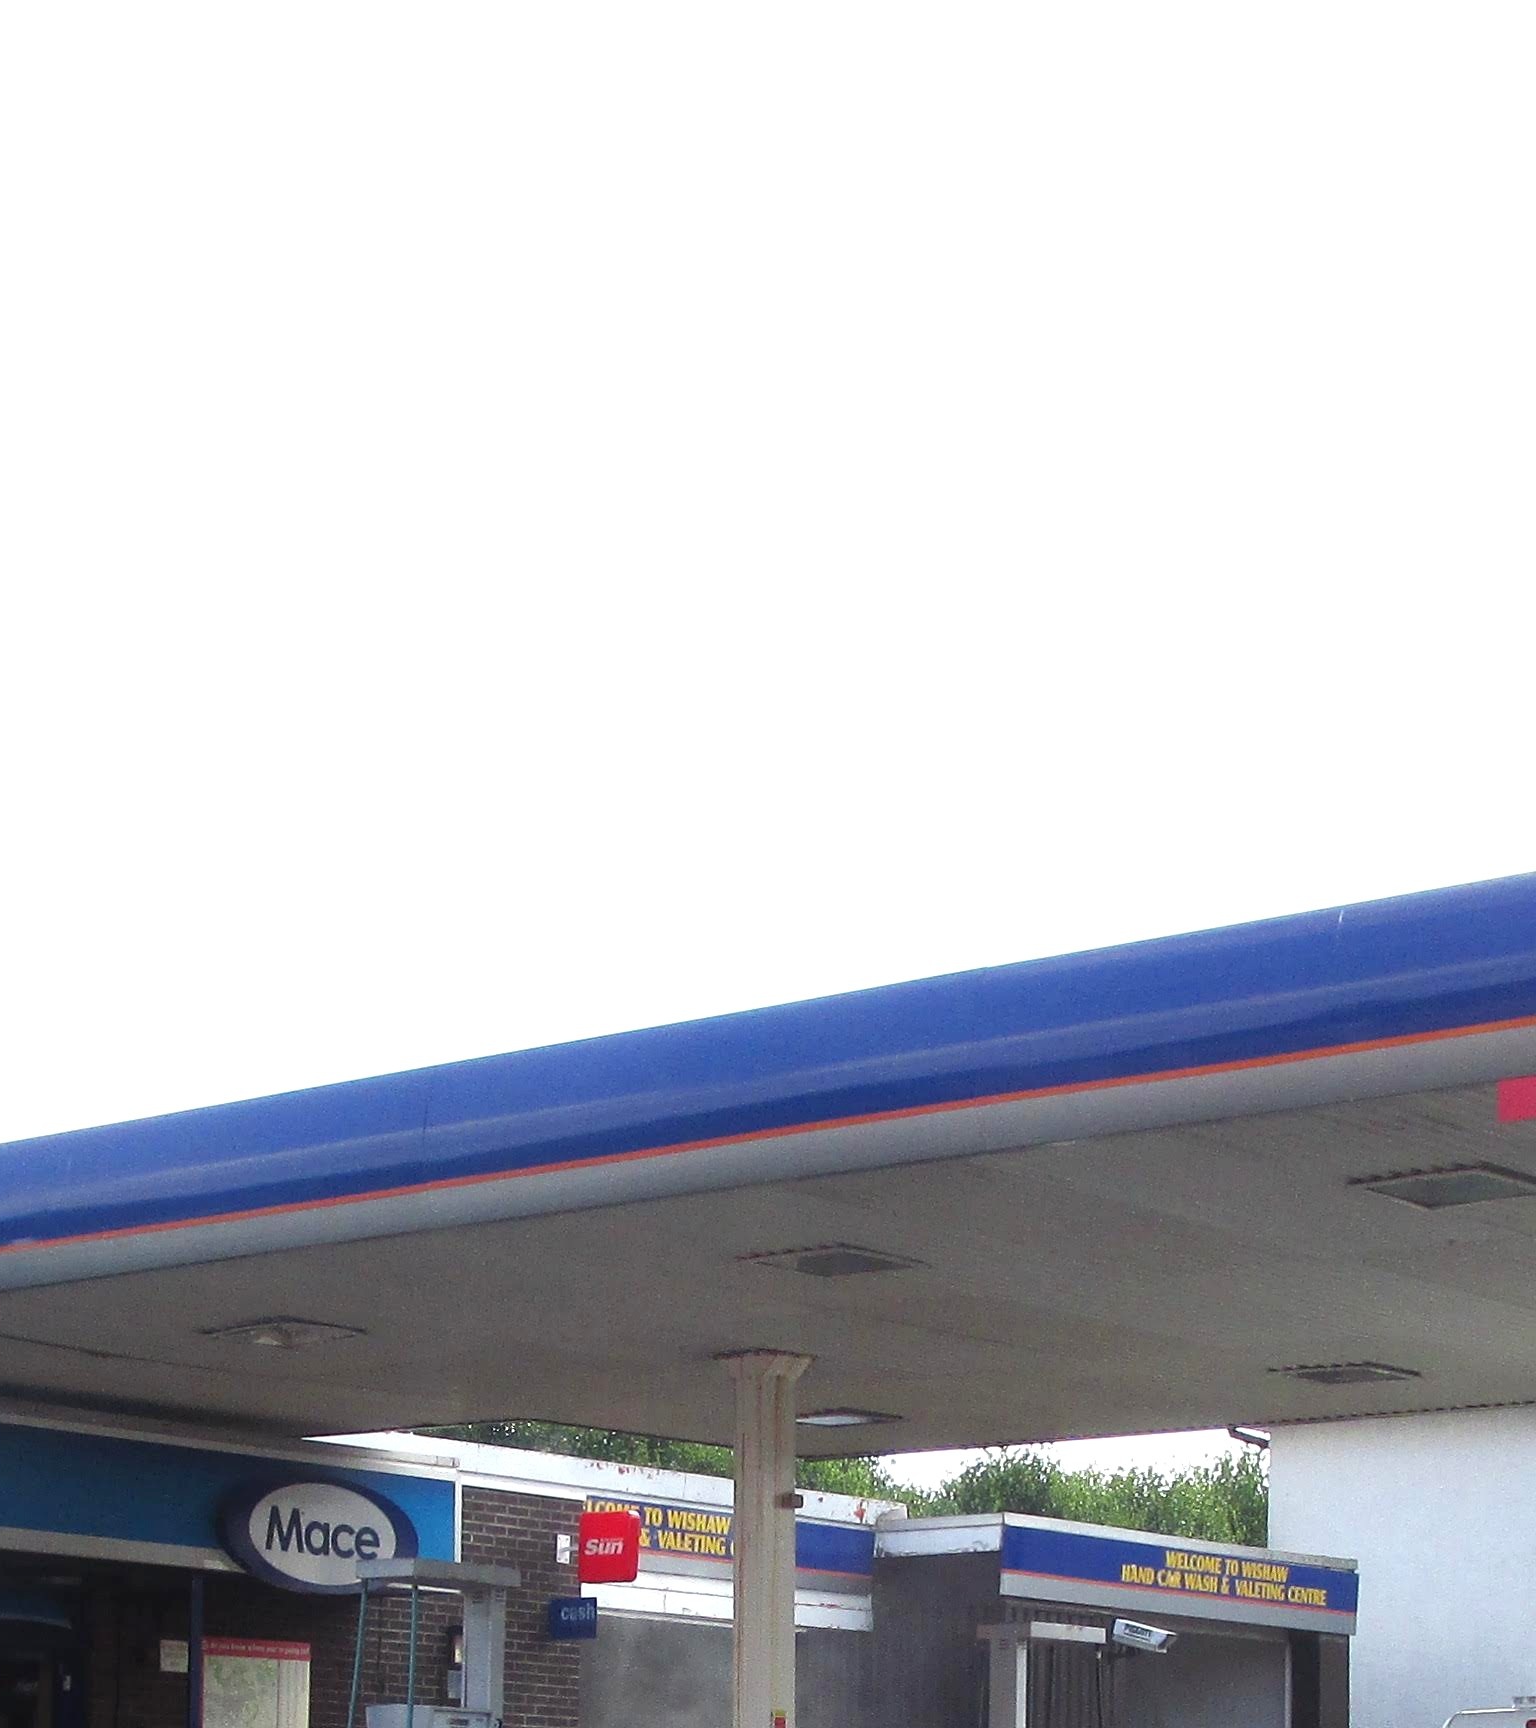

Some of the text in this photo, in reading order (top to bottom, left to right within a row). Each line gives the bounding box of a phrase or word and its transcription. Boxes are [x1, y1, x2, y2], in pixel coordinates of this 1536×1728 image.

[265, 1504, 381, 1560] Mace
[644, 1507, 663, 1526] TO
[667, 1509, 732, 1535] WISHAW
[584, 1538, 624, 1555] Sun
[638, 1527, 651, 1548] &
[657, 1531, 727, 1556] VALETING
[1165, 1550, 1290, 1583] WELCOME TO WISHAW
[1121, 1564, 1328, 1606] HAND CAR WASH & VALETING CENTRE
[561, 1602, 596, 1621] cash
